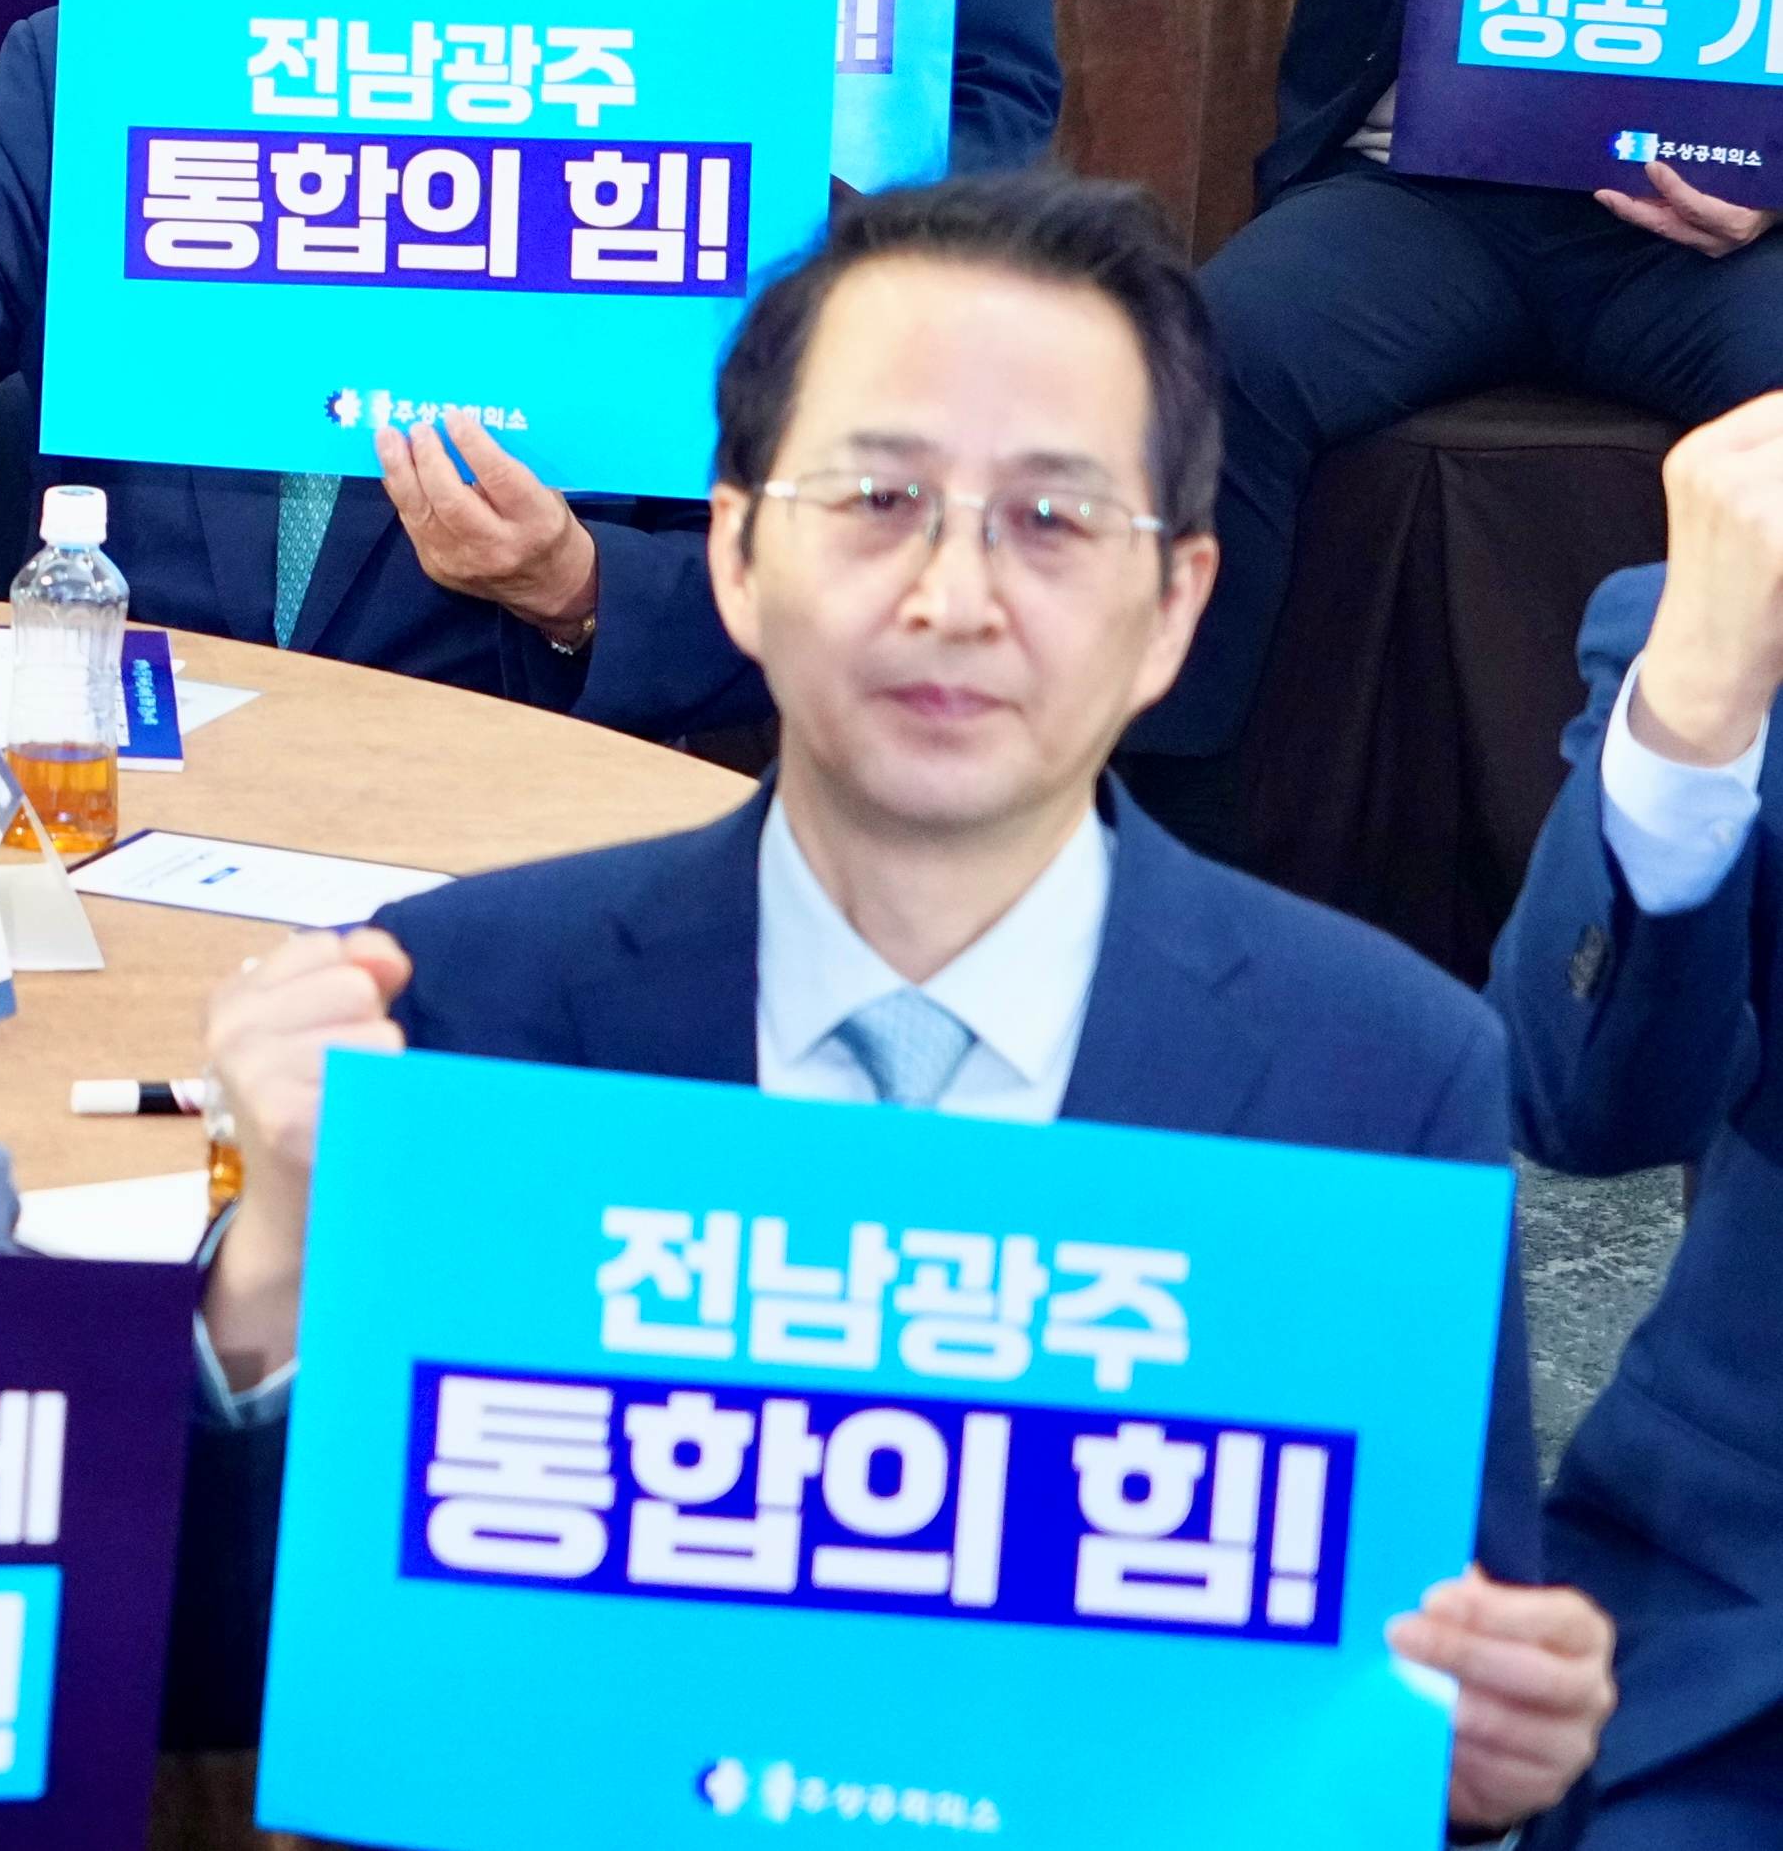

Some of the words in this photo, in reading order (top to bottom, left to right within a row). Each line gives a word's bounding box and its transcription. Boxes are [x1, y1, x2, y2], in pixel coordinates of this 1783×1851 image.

[246, 16, 636, 127] 전남광주
[142, 139, 518, 277] 통합의
[566, 150, 731, 285] 힘!
[1645, 137, 1763, 167] 주상공회의소
[596, 1206, 1191, 1391] 전남광주
[426, 1374, 1013, 1610] 통합의
[1071, 1421, 1330, 1628] 힘!
